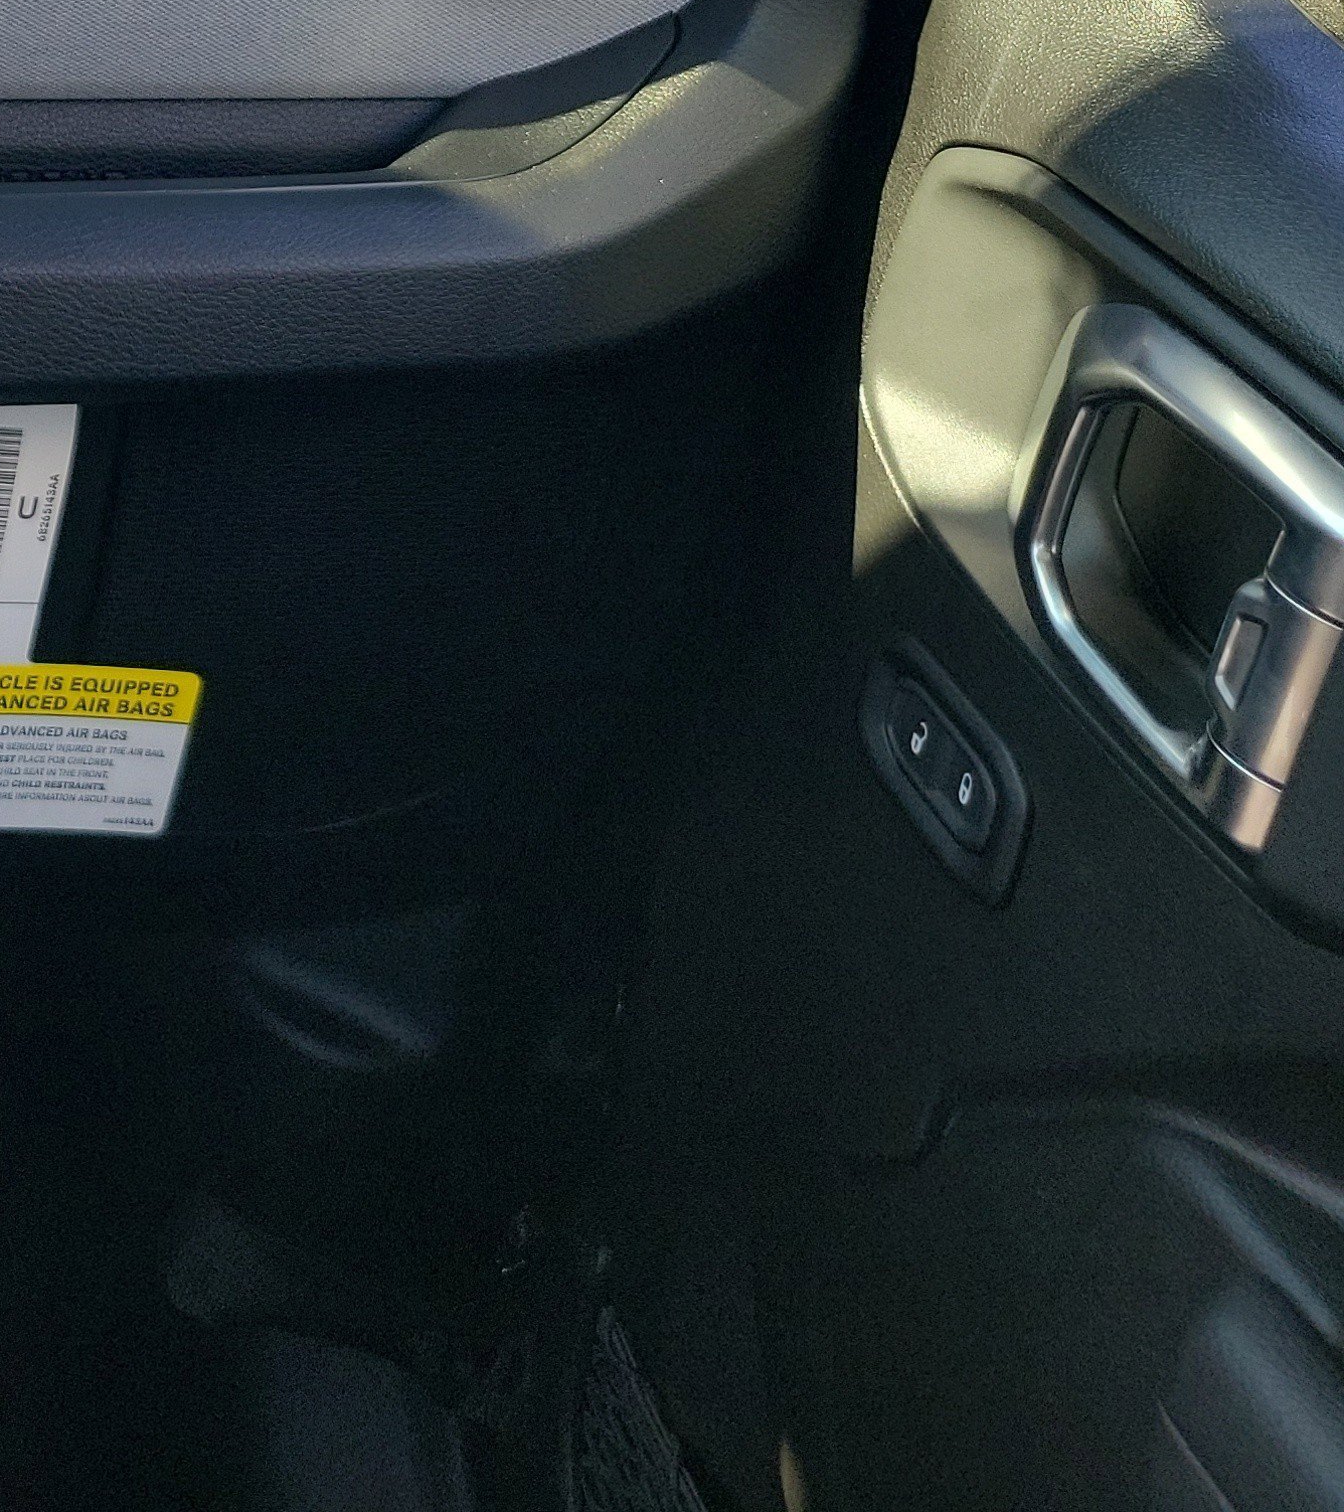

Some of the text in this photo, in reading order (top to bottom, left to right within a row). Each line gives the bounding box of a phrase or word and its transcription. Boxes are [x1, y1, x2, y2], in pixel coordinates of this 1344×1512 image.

[18, 495, 39, 519] U
[44, 675, 65, 690] IS
[69, 676, 180, 697] EQUIPPED
[73, 697, 110, 713] AIR
[115, 699, 175, 717] BAGS
[65, 727, 89, 738] AIR
[92, 729, 128, 741] BAGS
[11, 779, 42, 788] CHILD
